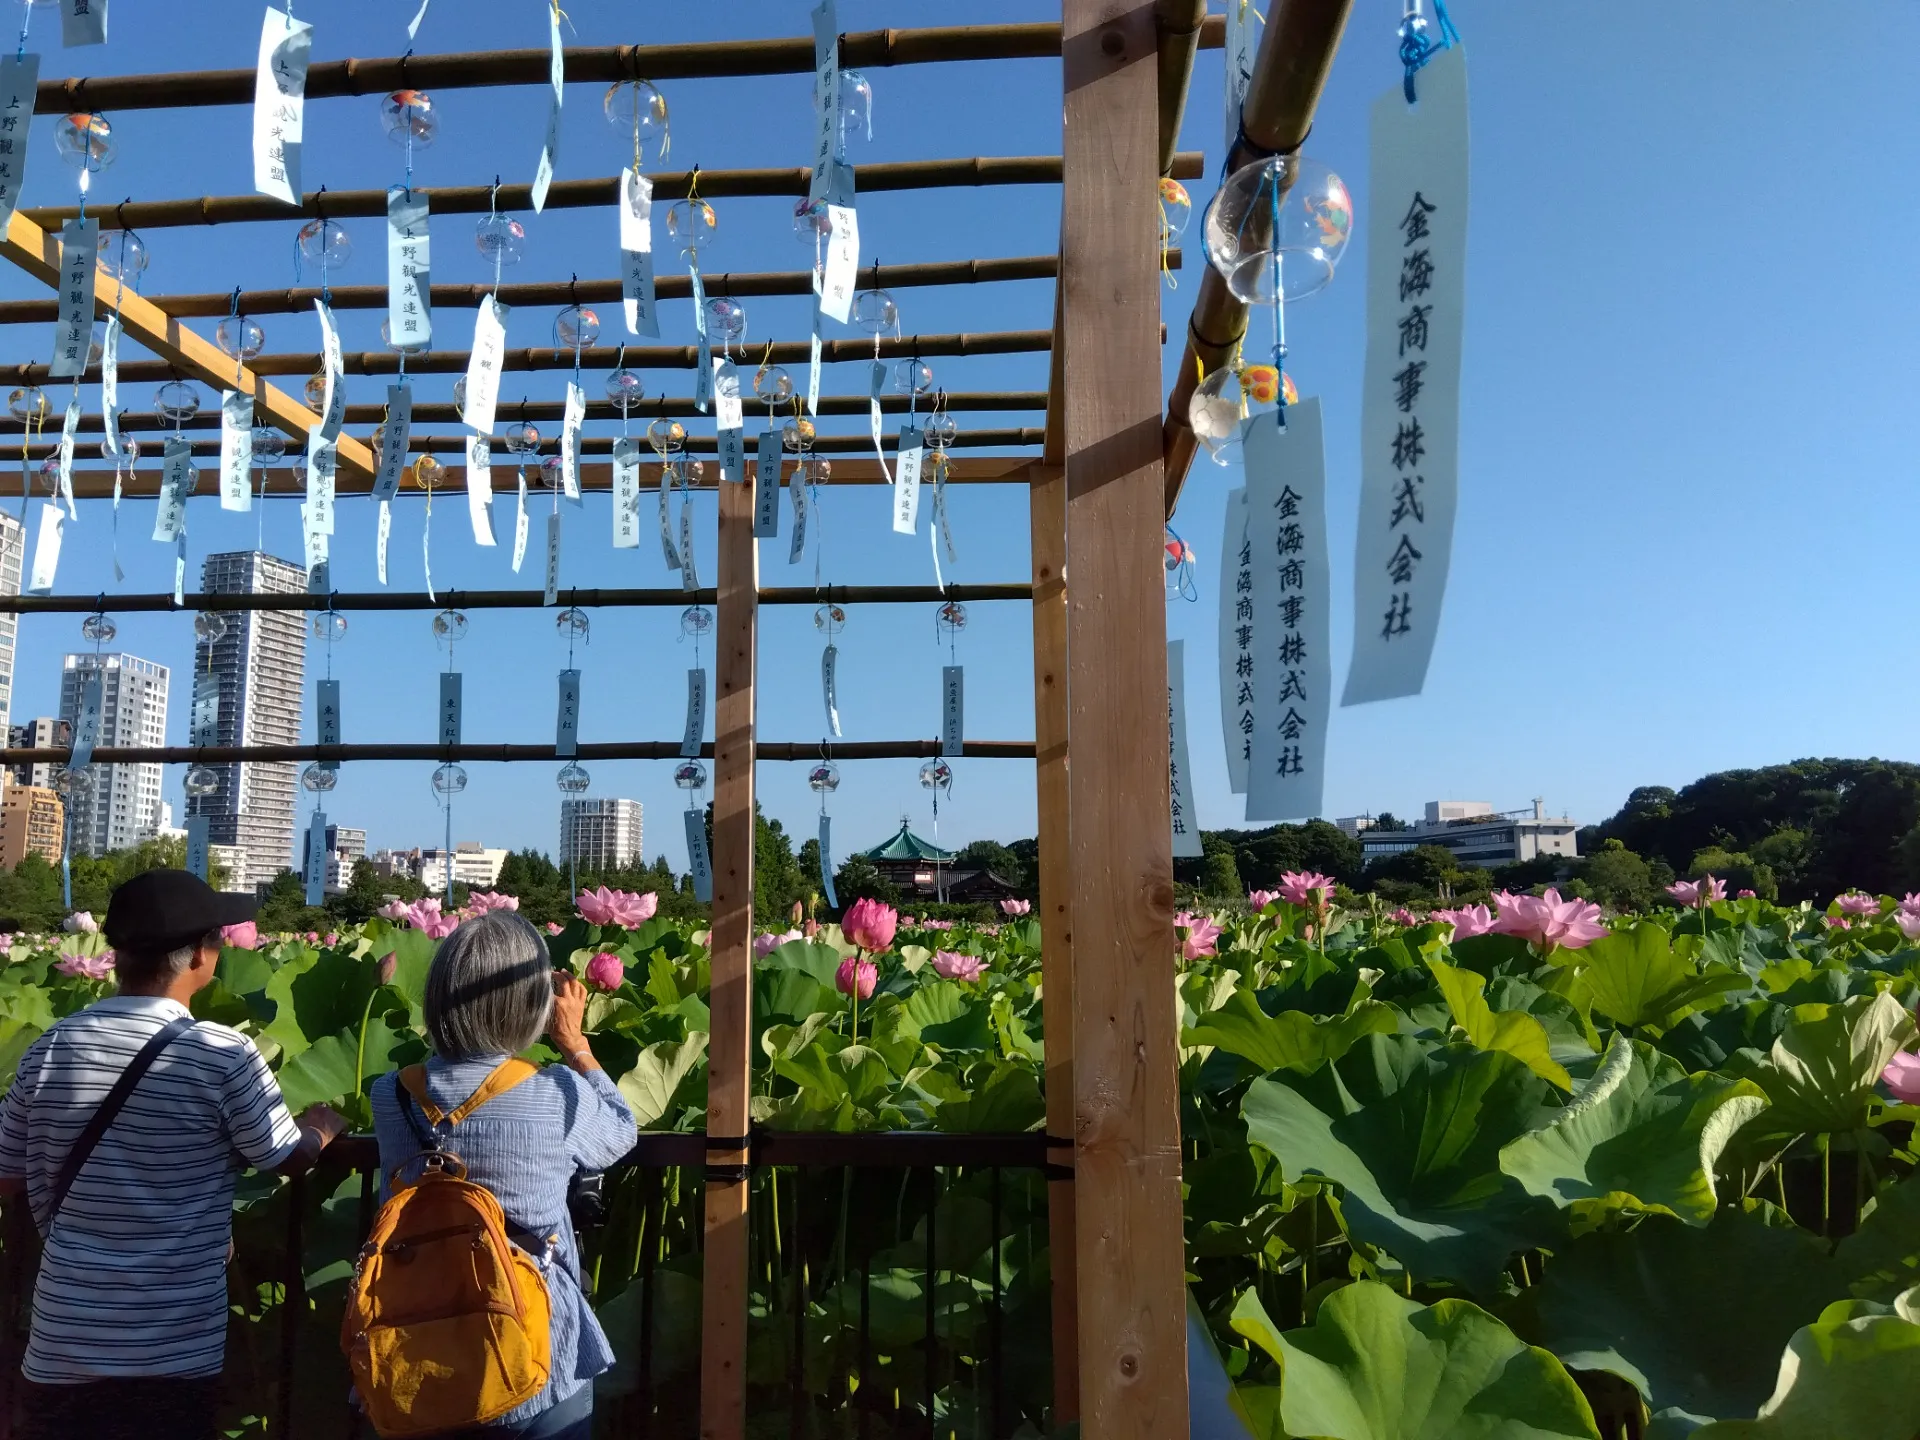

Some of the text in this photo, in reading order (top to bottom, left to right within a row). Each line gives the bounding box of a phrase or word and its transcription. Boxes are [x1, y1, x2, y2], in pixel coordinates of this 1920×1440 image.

[65, 253, 84, 360] 上野観光連盟
[402, 227, 418, 332] 上野観光連盟
[382, 412, 404, 490] 上野観光連盟
[1381, 191, 1437, 641] 金海商事株式会社
[165, 461, 182, 531] 上野観光連盟
[315, 450, 327, 522] 上野観光連盟
[621, 462, 632, 536] 上野観光連盟
[762, 453, 774, 525] 上野観光連盟
[901, 451, 914, 522] 上野観光連盟
[1274, 484, 1307, 778] 金海商事株式会社
[82, 707, 96, 742] 東天紅
[201, 699, 213, 737] 東天紅
[323, 705, 335, 743] 東天紅
[445, 698, 456, 736] 東天紅
[562, 692, 574, 729] 東天紅
